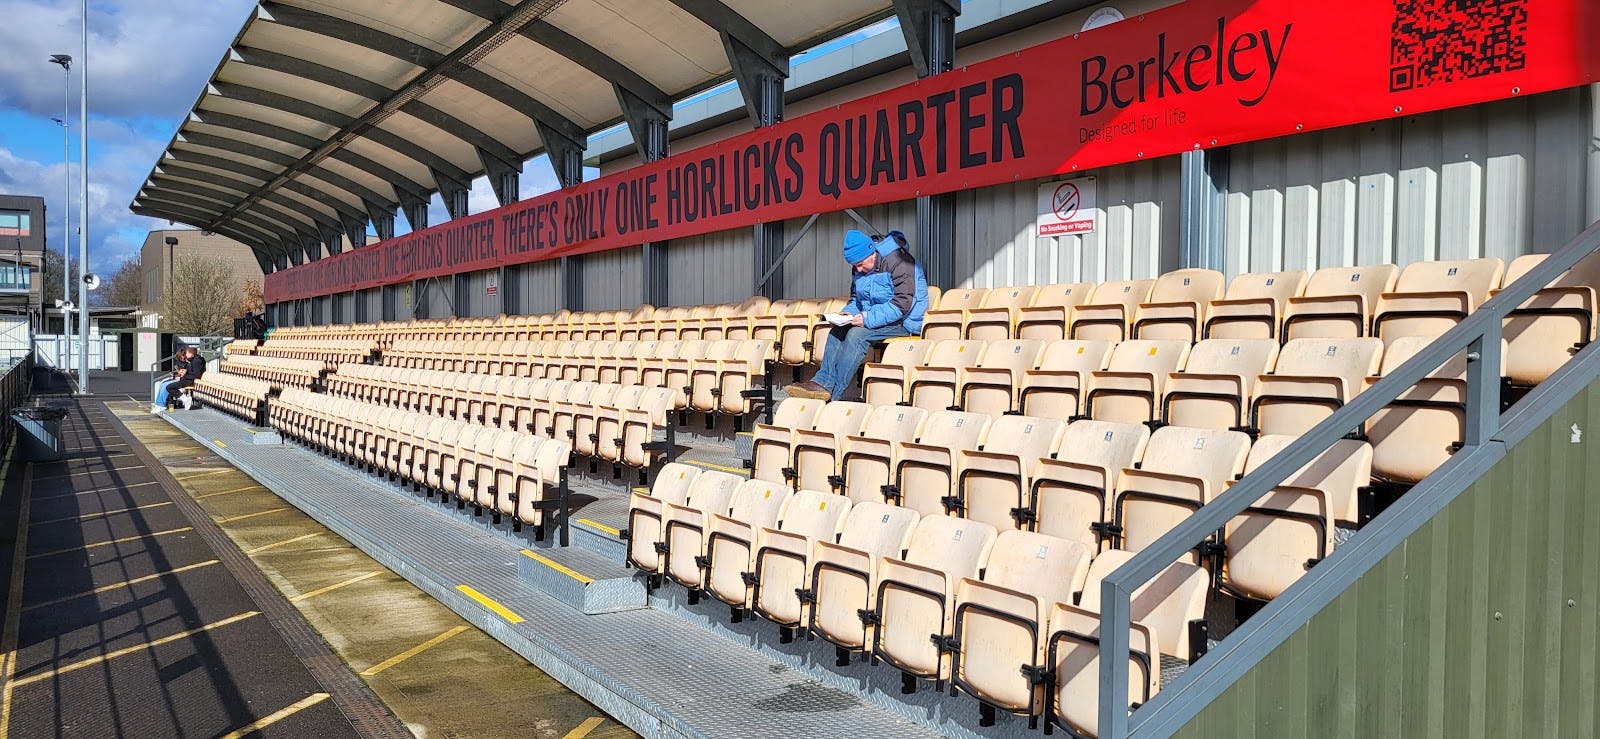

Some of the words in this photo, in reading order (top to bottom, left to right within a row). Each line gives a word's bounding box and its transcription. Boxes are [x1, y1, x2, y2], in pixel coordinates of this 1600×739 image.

[1080, 16, 1292, 107] Berkeley
[1080, 116, 1136, 143] Designed
[1142, 114, 1158, 132] for
[1164, 109, 1186, 126] life
[384, 244, 399, 278] ONE
[401, 232, 442, 275] HORLICKS
[446, 218, 498, 268] QUARTER,
[502, 201, 558, 256] THERE'S
[564, 187, 609, 245] ONLY
[616, 173, 659, 236] ONE
[667, 132, 804, 219] HORLICKS
[818, 72, 1024, 201] QUARTER
[1074, 222, 1092, 230] Vaping
